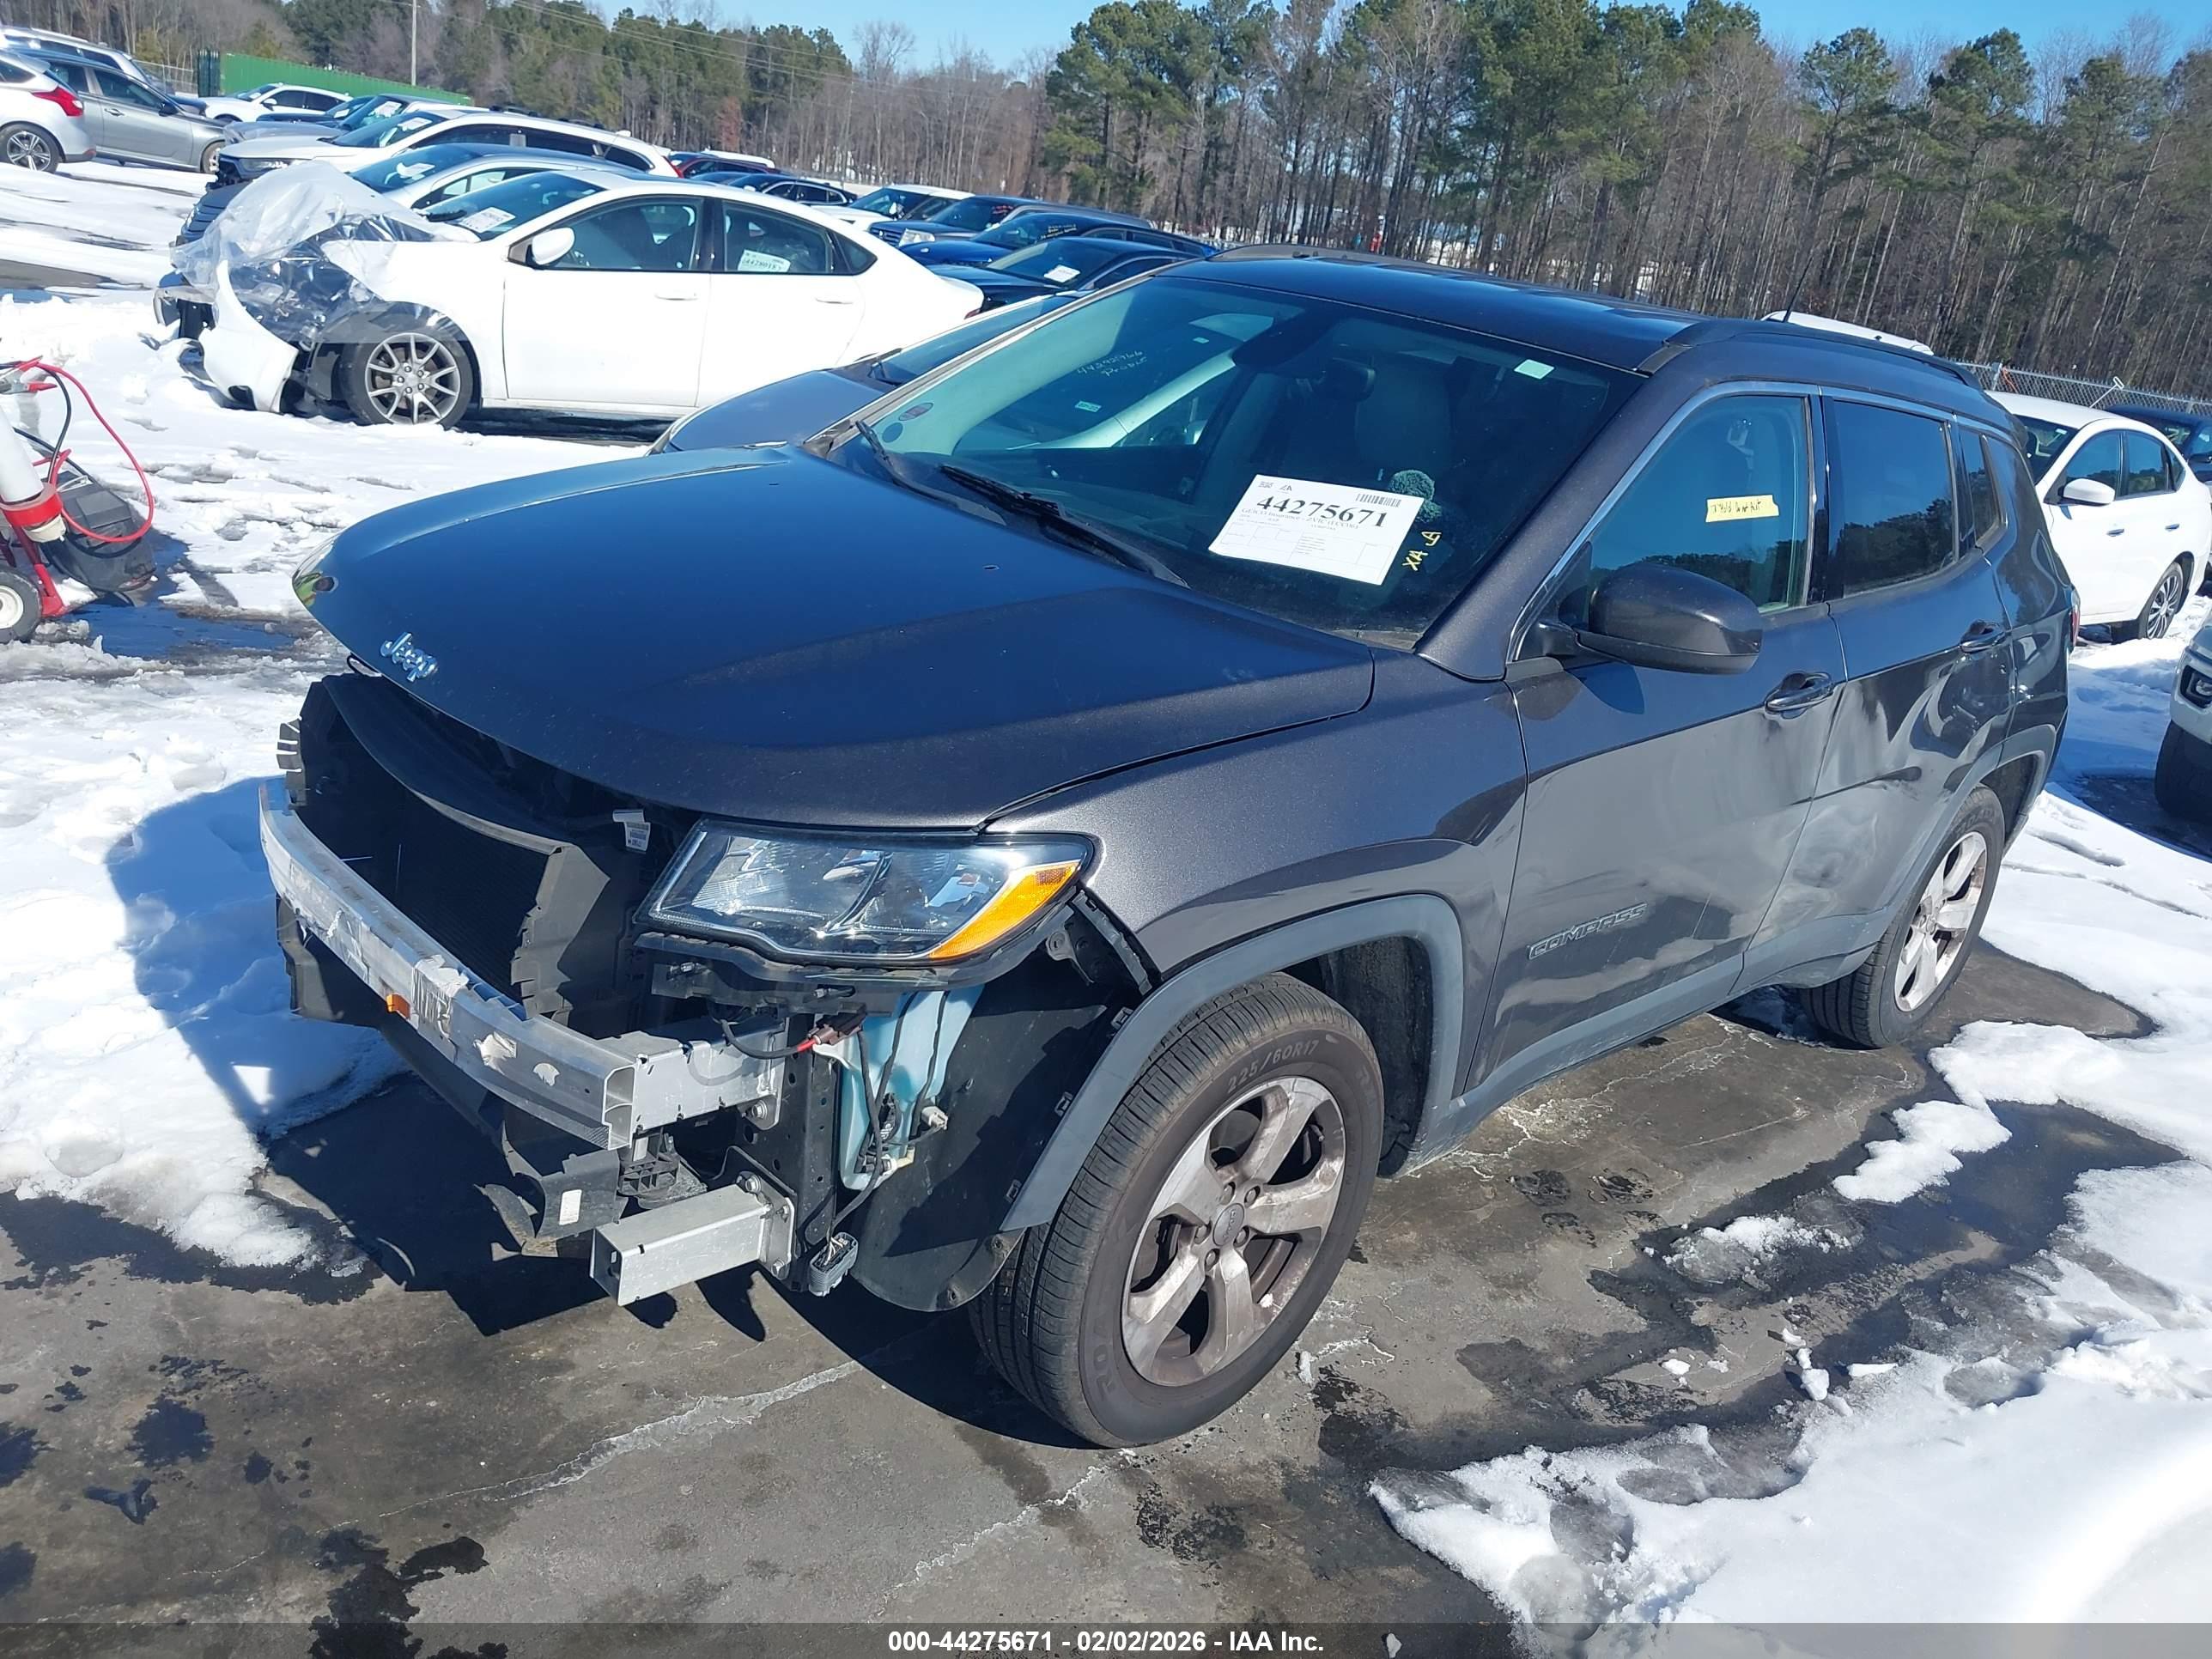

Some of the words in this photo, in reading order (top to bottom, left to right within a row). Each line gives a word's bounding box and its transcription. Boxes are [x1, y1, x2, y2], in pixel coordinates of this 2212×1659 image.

[1256, 495, 1388, 527] 44275671
[380, 632, 438, 683] Jeep
[1527, 901, 1648, 960] COMPASS
